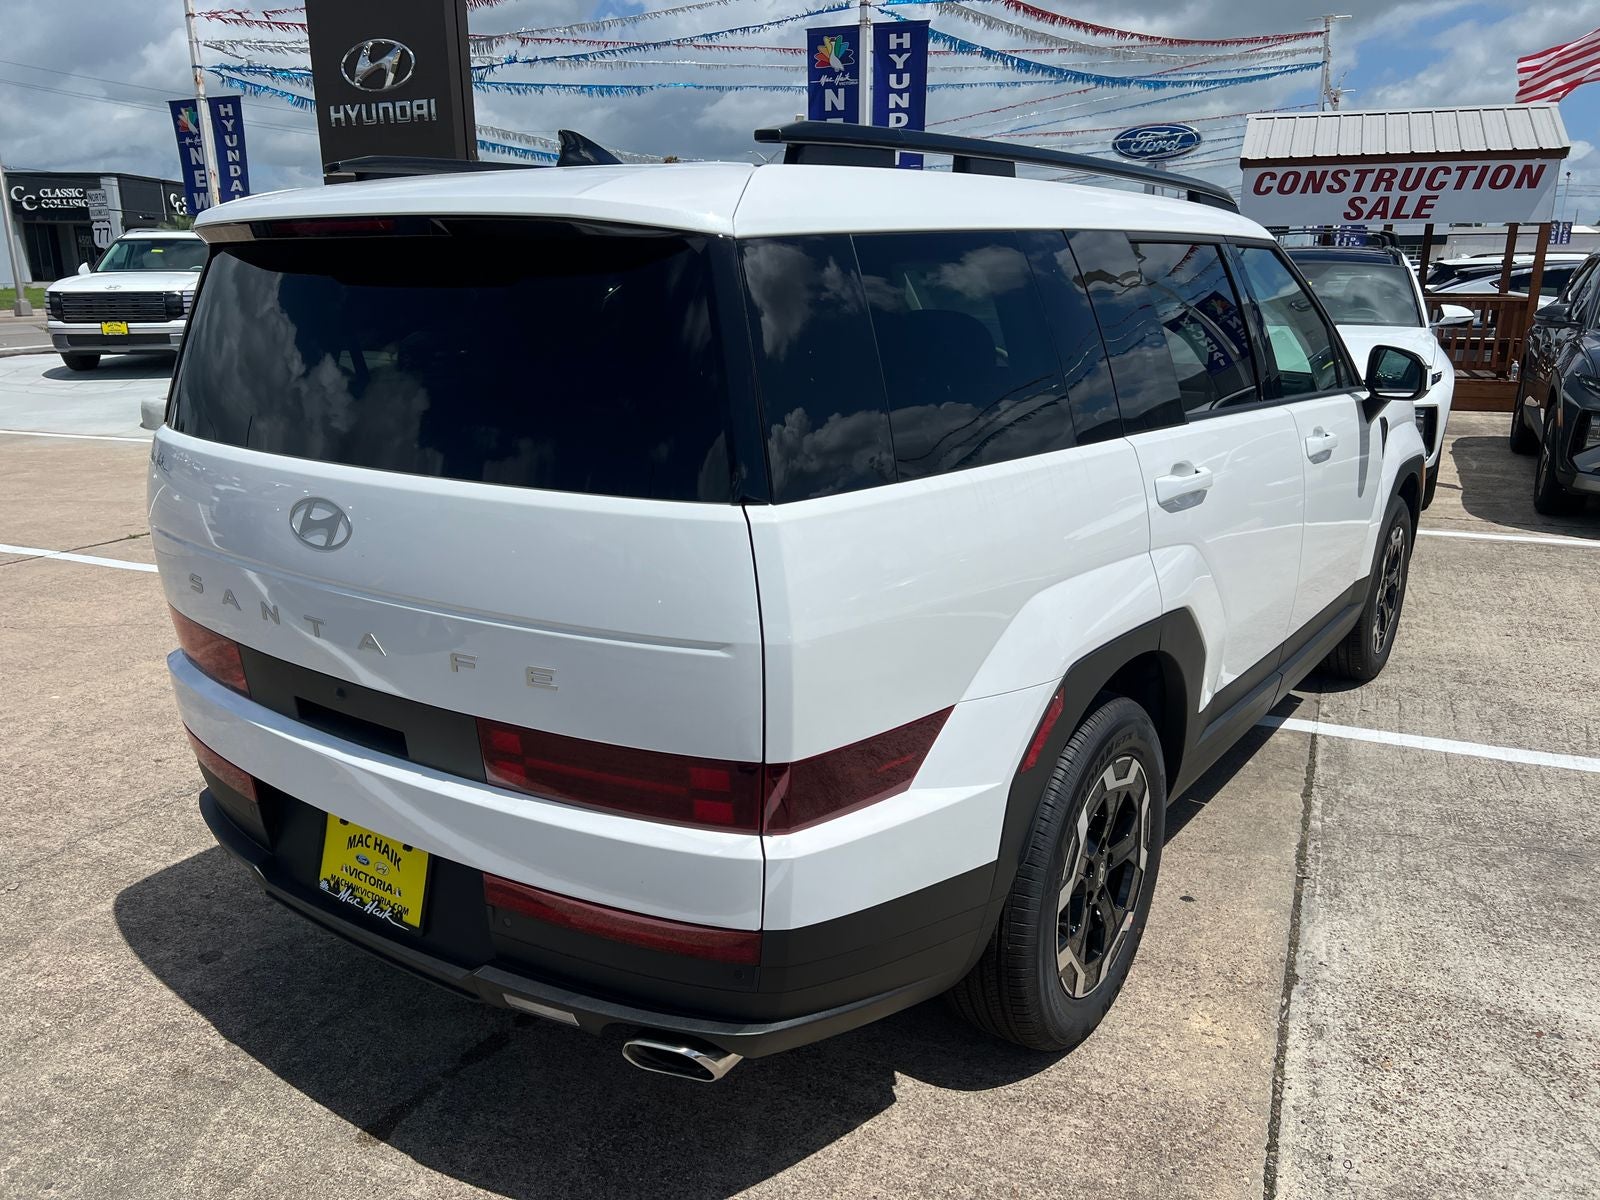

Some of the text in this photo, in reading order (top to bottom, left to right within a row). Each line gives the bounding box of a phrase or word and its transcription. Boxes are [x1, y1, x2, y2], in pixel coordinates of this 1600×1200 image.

[329, 98, 437, 127] HYUNDAI
[1130, 130, 1184, 153] Ford
[39, 188, 84, 198] CLASSIC
[189, 147, 211, 210] NEW
[1252, 163, 1547, 196] CONSTRUCTION
[41, 199, 90, 208] COLLISIO
[87, 191, 106, 202] NORTH
[1342, 194, 1440, 221] SALE
[94, 227, 110, 243] 77
[188, 572, 388, 657] SANTA
[449, 652, 559, 691] FE
[347, 833, 372, 850] MAC
[373, 837, 402, 872] HAIK
[330, 874, 410, 916] MACHAIKVICTORIA.COM
[348, 866, 393, 895] VICTORIA
[338, 886, 394, 919] Mac Haik
